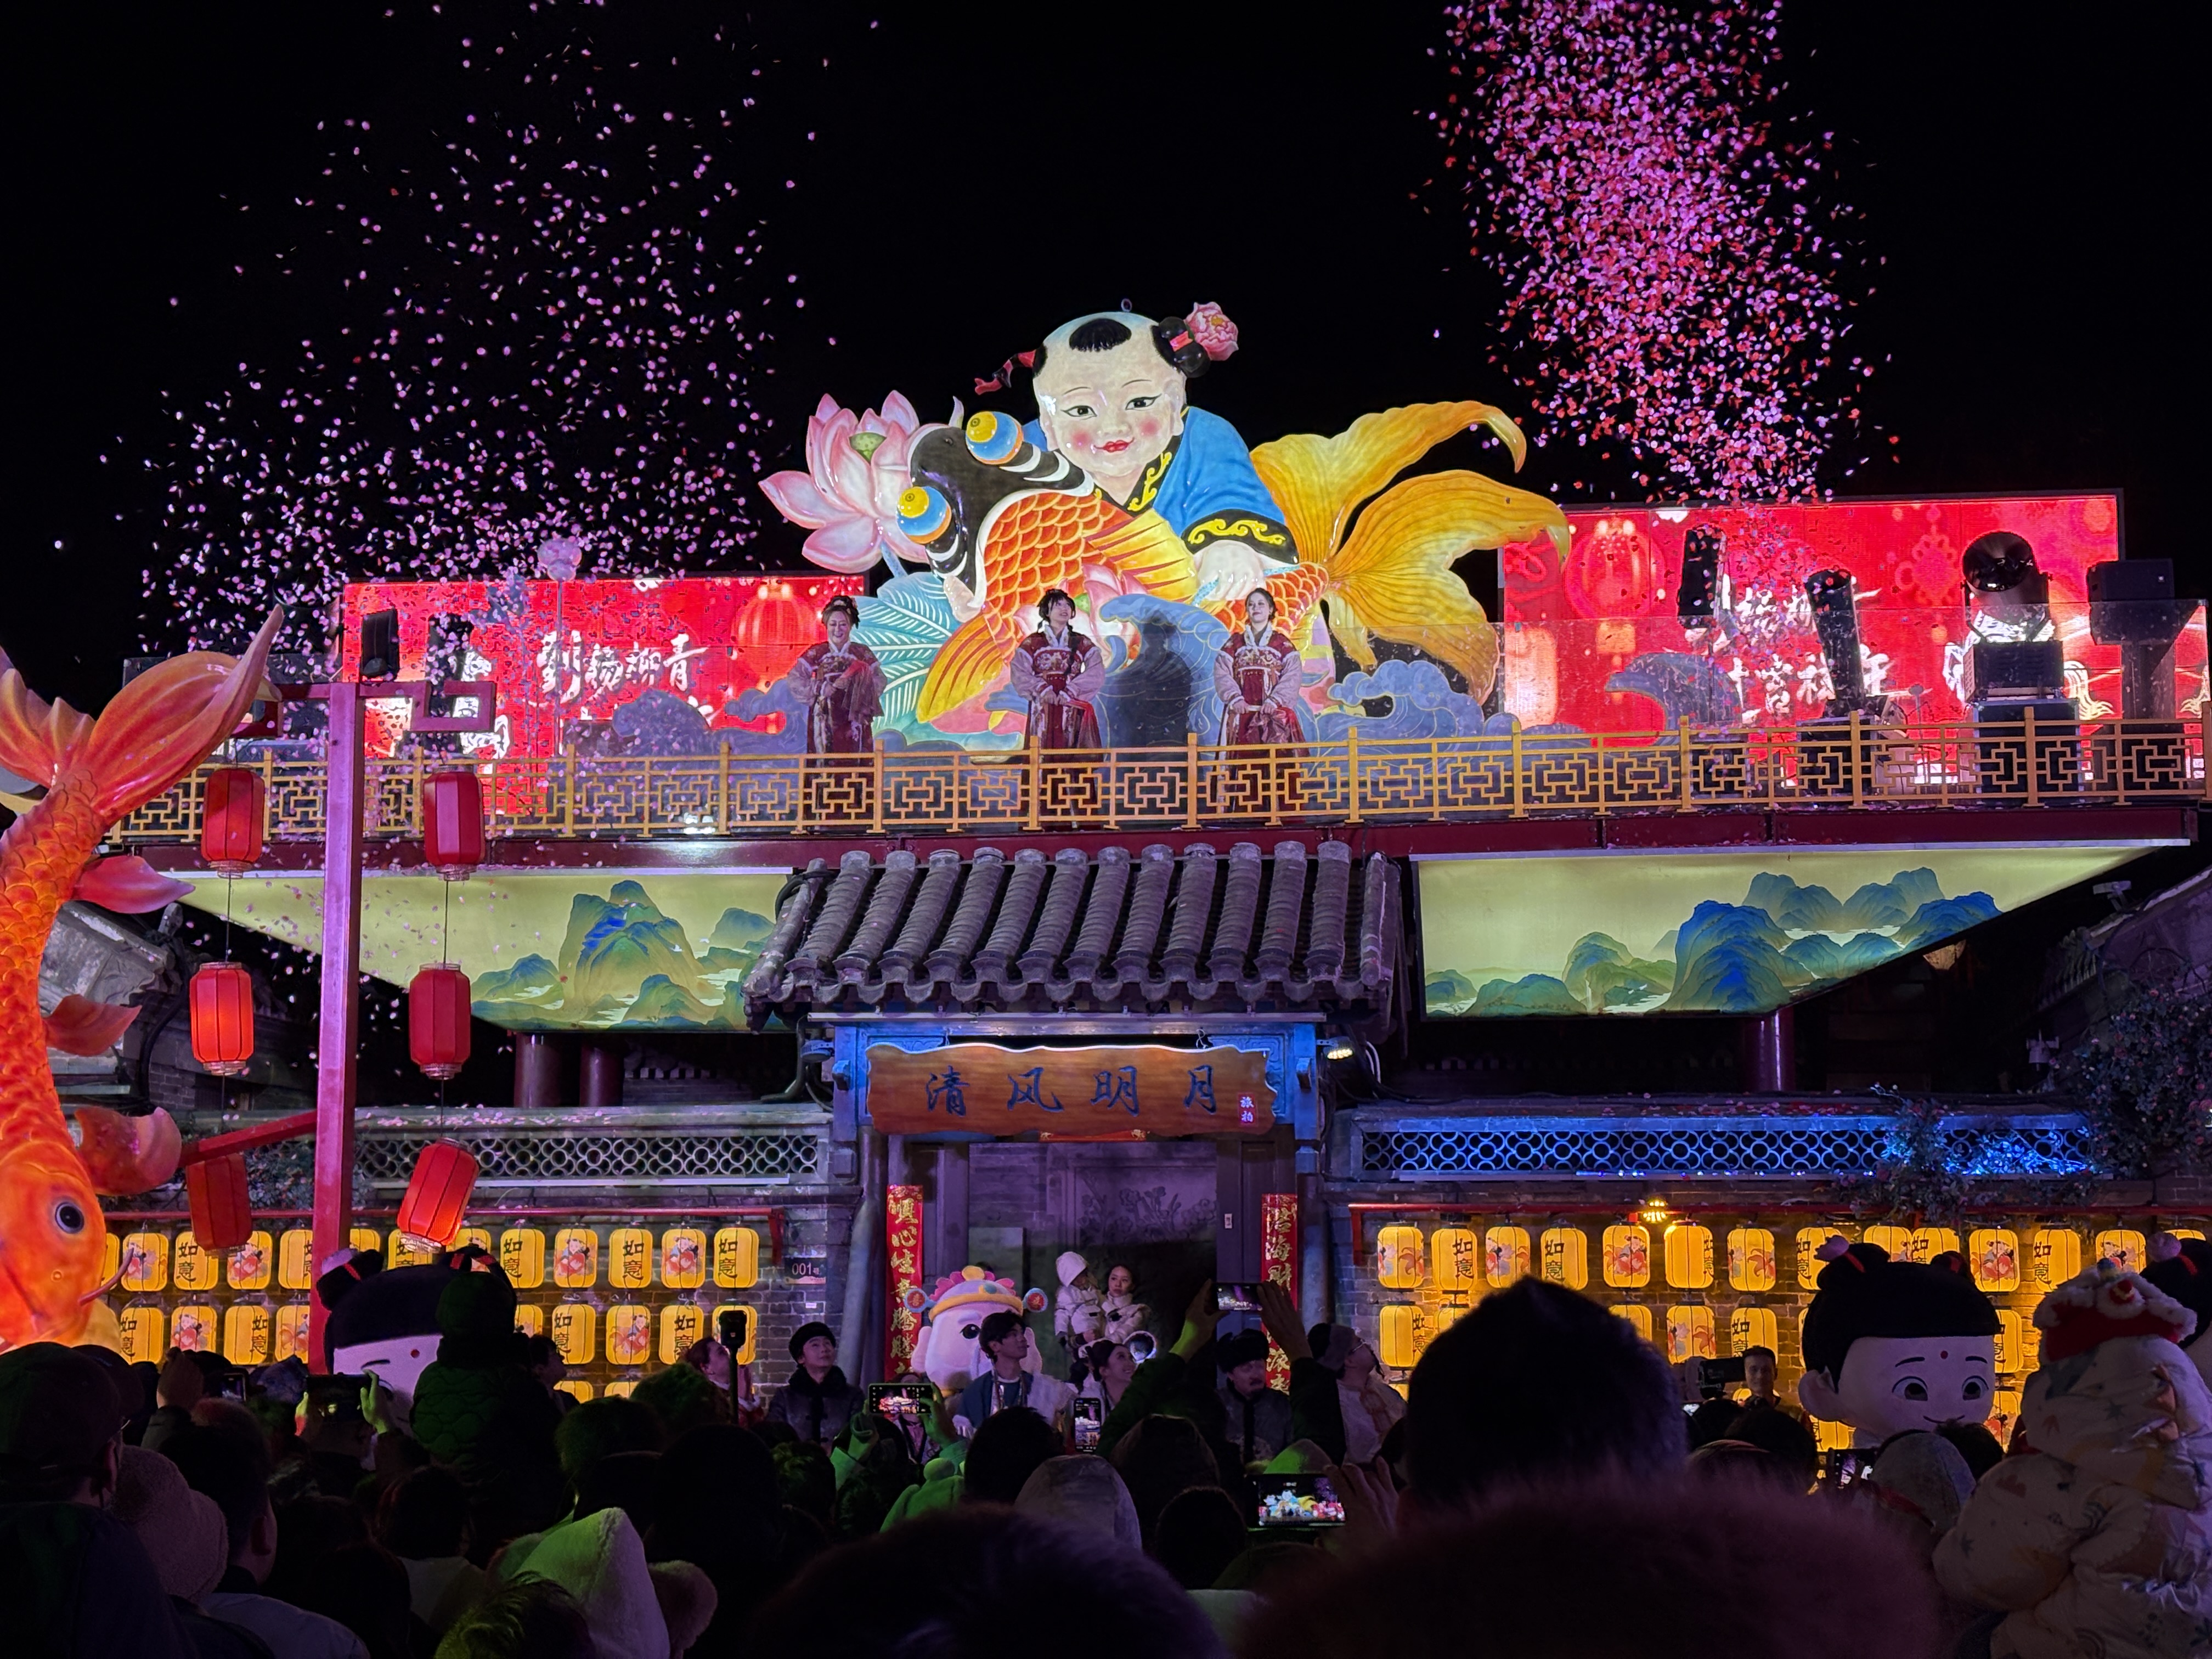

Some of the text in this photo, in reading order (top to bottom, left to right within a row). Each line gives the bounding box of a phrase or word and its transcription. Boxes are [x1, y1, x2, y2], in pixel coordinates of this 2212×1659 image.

[926, 1064, 1217, 1117] 清风明月
[1240, 1096, 1255, 1123] 旅拍
[176, 1242, 198, 1282] 如意
[503, 1238, 523, 1278] 如意
[623, 1239, 645, 1280] 如意
[719, 1238, 738, 1279] 如意
[1452, 1238, 1474, 1279] 如意
[1544, 1239, 1565, 1281] 如意
[1797, 1237, 1812, 1279] 如意
[2034, 1241, 2052, 1285] 如意
[120, 1316, 137, 1357] 如意
[250, 1315, 268, 1356] 如意
[555, 1312, 573, 1353] 如意
